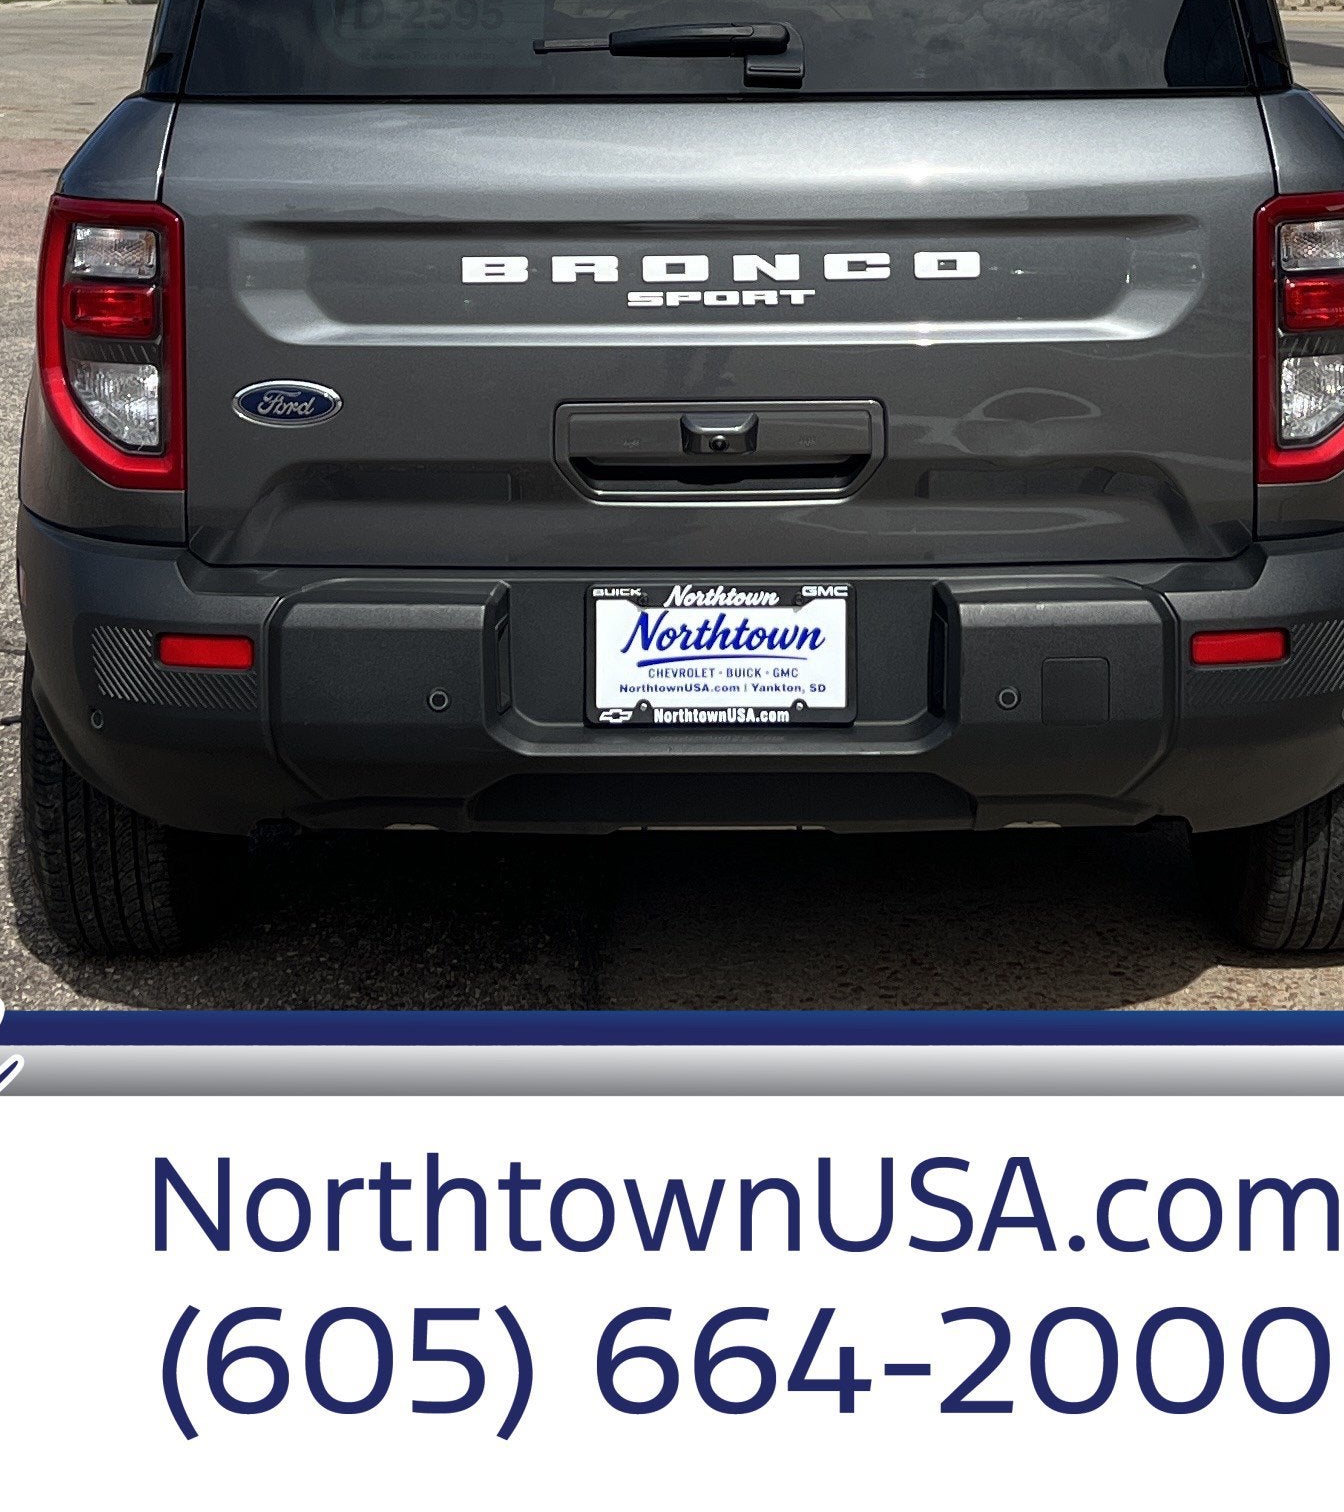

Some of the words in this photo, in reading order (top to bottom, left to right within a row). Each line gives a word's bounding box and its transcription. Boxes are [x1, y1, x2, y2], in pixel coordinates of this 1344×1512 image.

[461, 250, 981, 284] BRONCO
[626, 289, 816, 307] SPORT
[256, 389, 316, 416] Ford
[592, 588, 642, 597] BUICK
[663, 584, 780, 607] Northtown
[801, 585, 849, 597] GMC
[620, 610, 826, 654] Northtown
[648, 667, 715, 678] CHEVROLET
[726, 667, 762, 678] BUICK
[772, 667, 799, 678] GMC
[619, 683, 740, 693] NorthtownUSA.com
[751, 683, 805, 695] Yankton,
[809, 683, 827, 693] SD
[653, 707, 790, 724] NorthtownUSA.com
